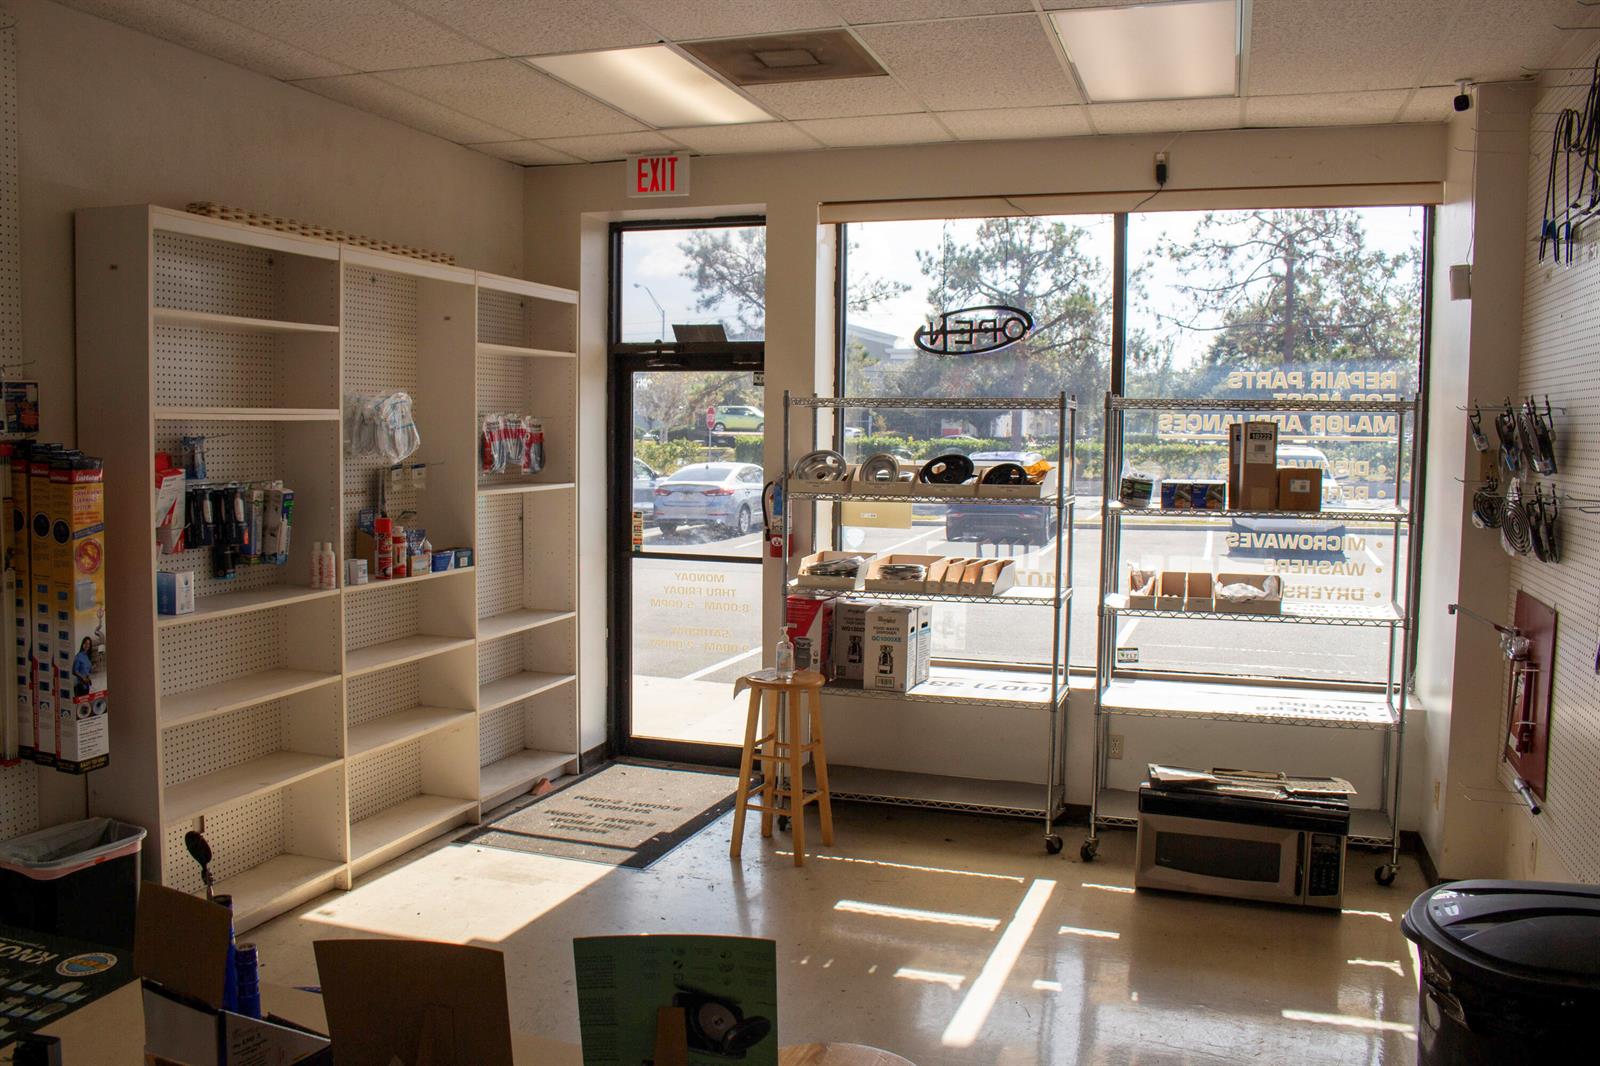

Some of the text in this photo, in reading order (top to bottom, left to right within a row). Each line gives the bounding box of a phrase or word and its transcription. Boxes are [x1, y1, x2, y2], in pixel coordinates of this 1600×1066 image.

[637, 157, 679, 193] EXIT
[585, 802, 653, 814] SATURDAY
[547, 816, 632, 831] THRU FRIDAY
[0, 942, 60, 965] KNO
